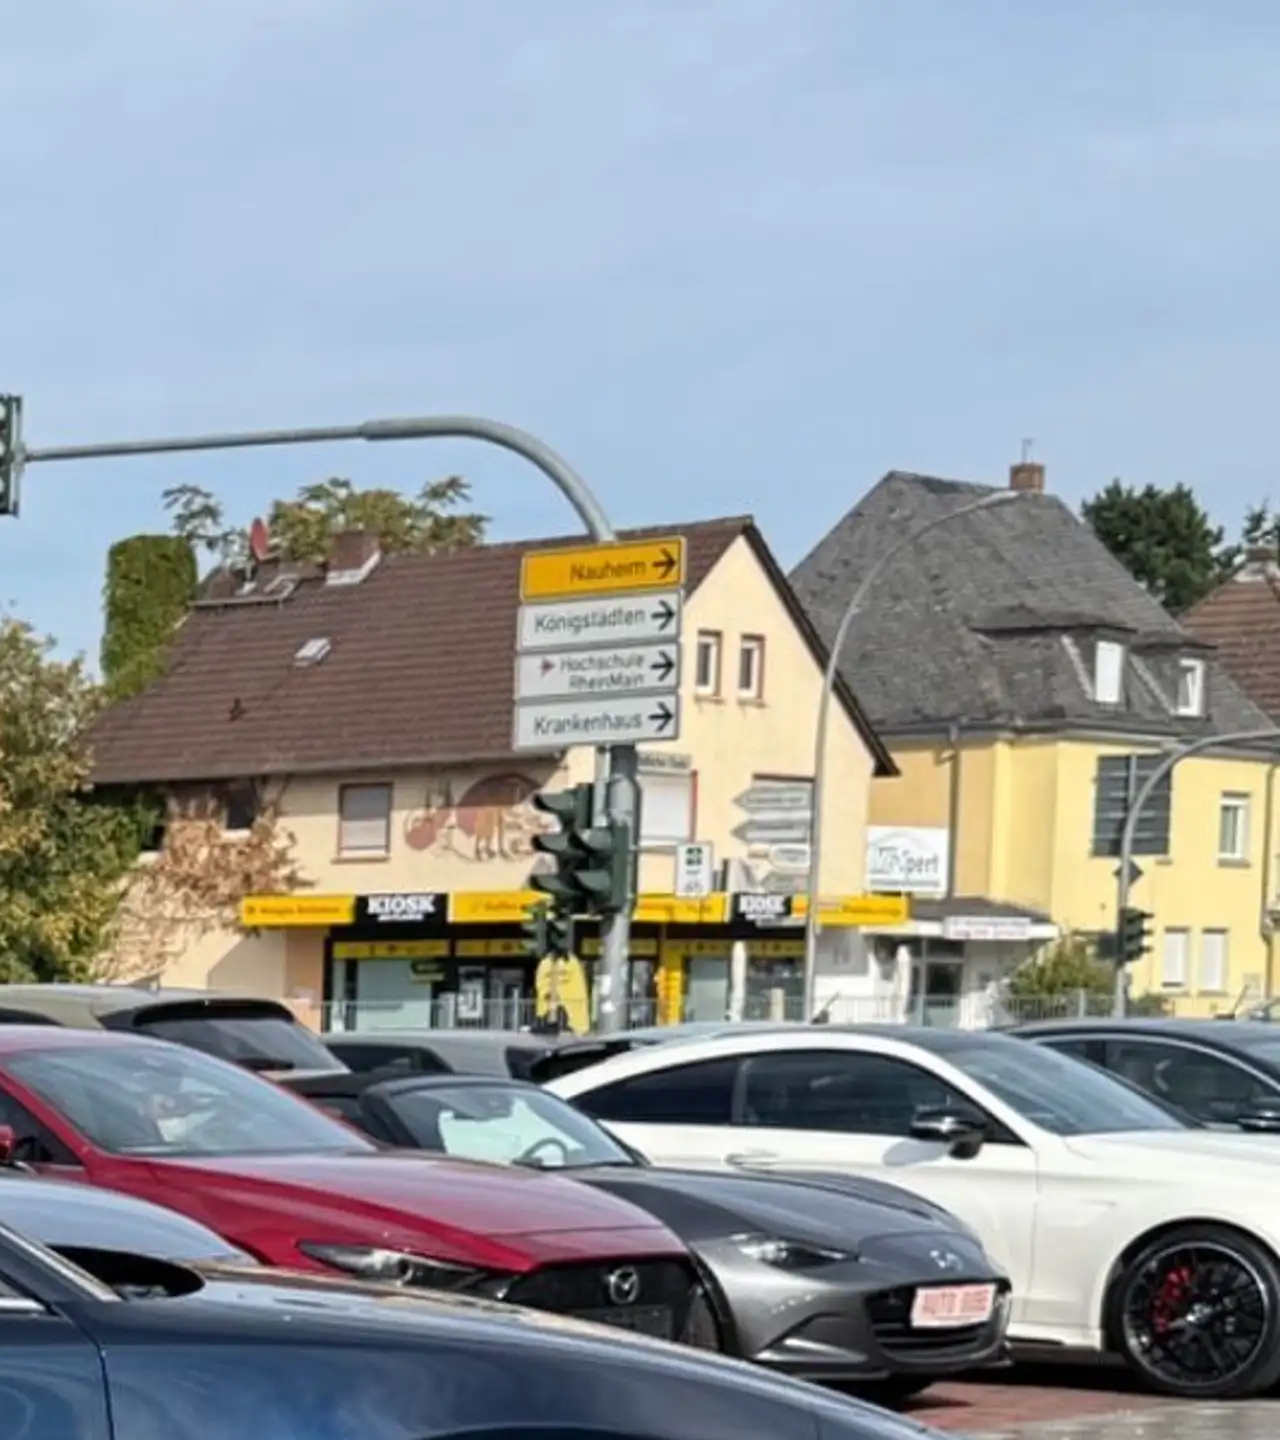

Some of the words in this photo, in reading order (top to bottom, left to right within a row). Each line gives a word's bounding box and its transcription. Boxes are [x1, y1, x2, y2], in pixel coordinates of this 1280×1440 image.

[570, 560, 646, 582] Nauheim
[534, 609, 646, 634] Königstädten
[559, 653, 645, 673] Hochschule
[568, 673, 645, 690] RheinMain
[533, 712, 643, 736] Krankenhaus
[367, 895, 435, 914] KIOSK
